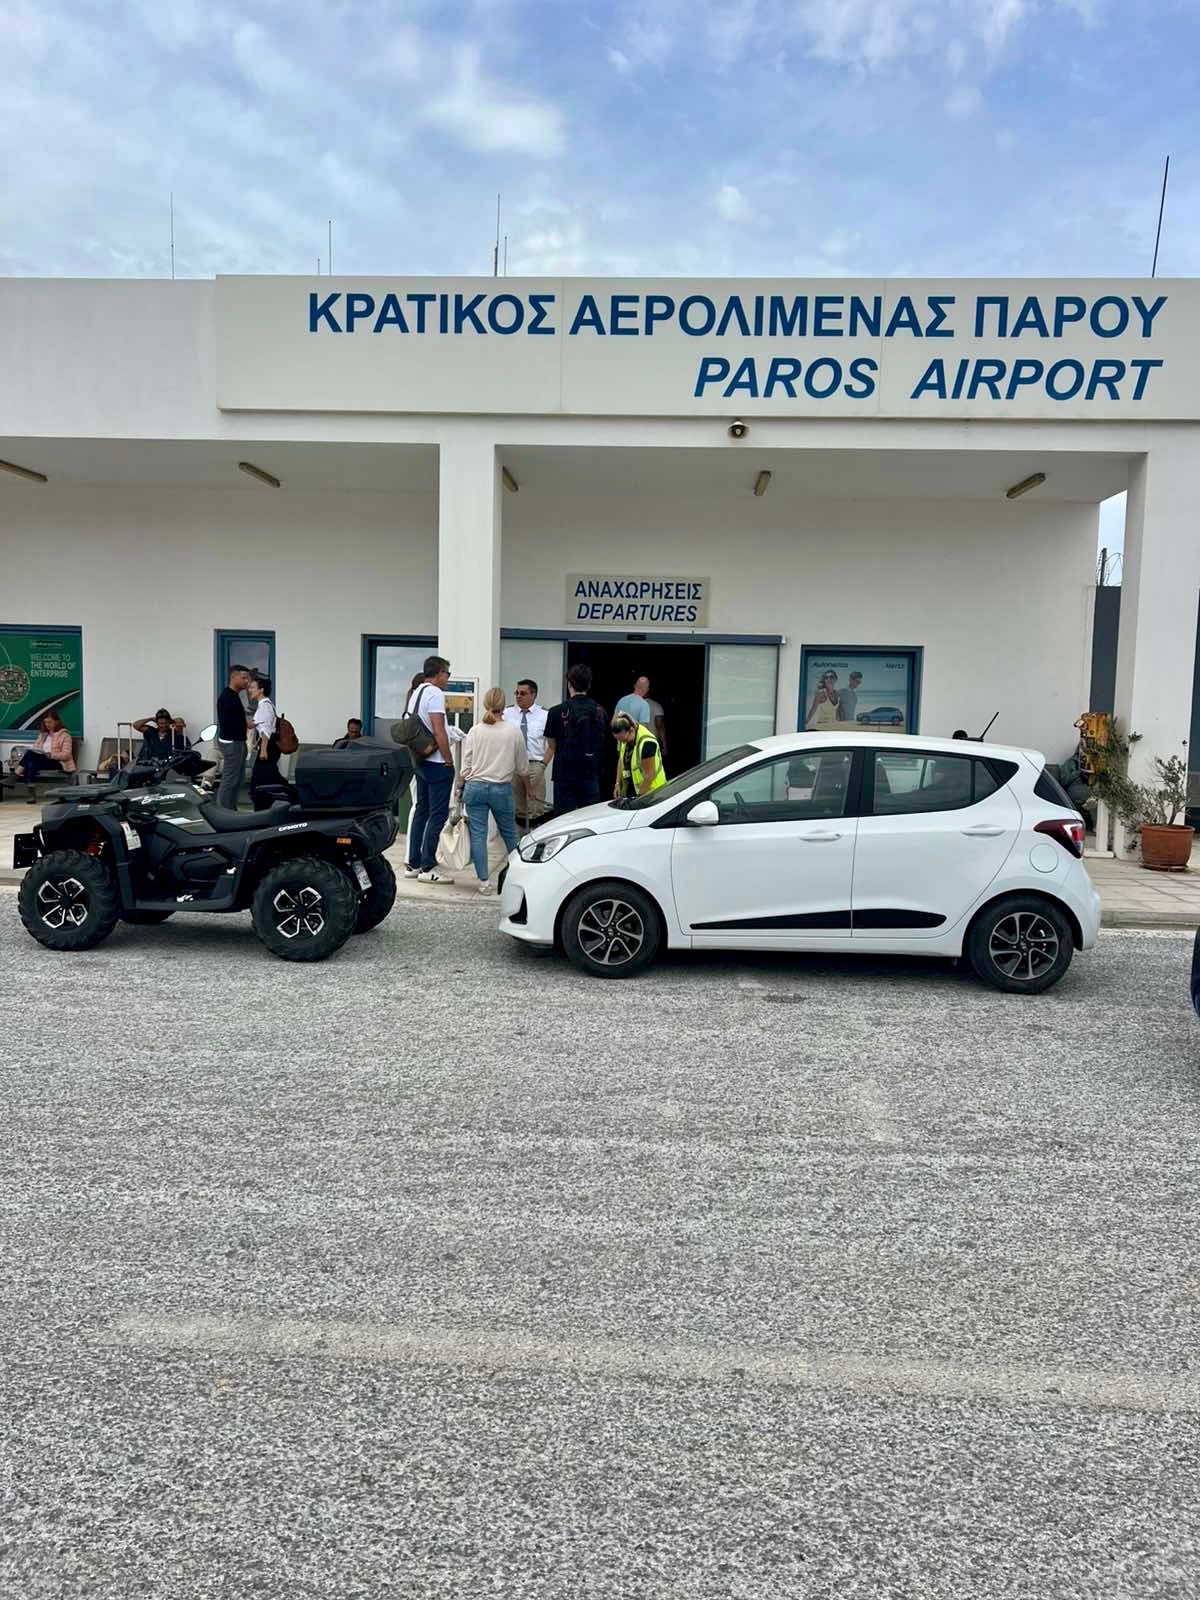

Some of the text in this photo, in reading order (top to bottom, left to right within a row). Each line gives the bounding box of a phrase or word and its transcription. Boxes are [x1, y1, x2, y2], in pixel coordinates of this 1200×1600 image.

[309, 293, 1169, 338] ΚΡΑΤΙΚΟΣ ΑΕΡΟΛΙΜΕΝΑΣ ΠΑΡΟΥ
[694, 357, 1164, 401] PAROS AIRPORT
[574, 580, 702, 600] ΑΝΑΧΩΡΗΣΕΙΣ
[577, 602, 698, 622] DEPARTURES
[31, 662, 77, 670] THE WORLD OF
[31, 669, 69, 678] ENTERPRISE
